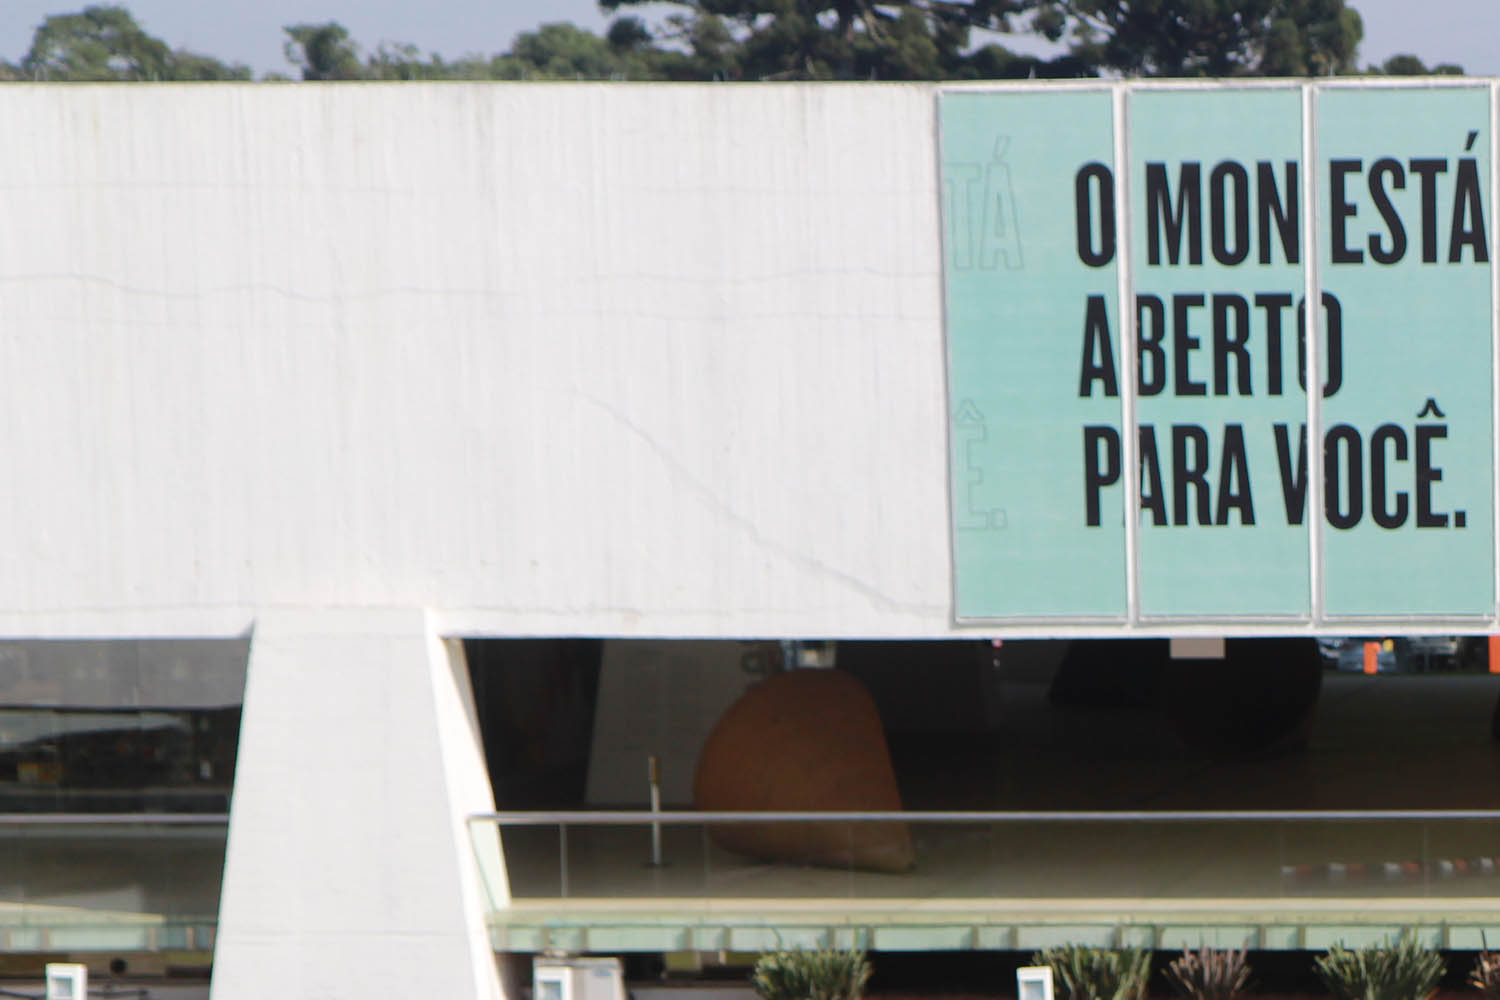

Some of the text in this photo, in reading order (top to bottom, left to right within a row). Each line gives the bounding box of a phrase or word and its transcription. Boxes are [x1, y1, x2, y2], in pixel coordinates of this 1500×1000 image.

[1075, 130, 1489, 267] O MON ESTÁ
[1079, 292, 1343, 397] ABERTO
[1083, 398, 1467, 530] PARA VOCÊ.
